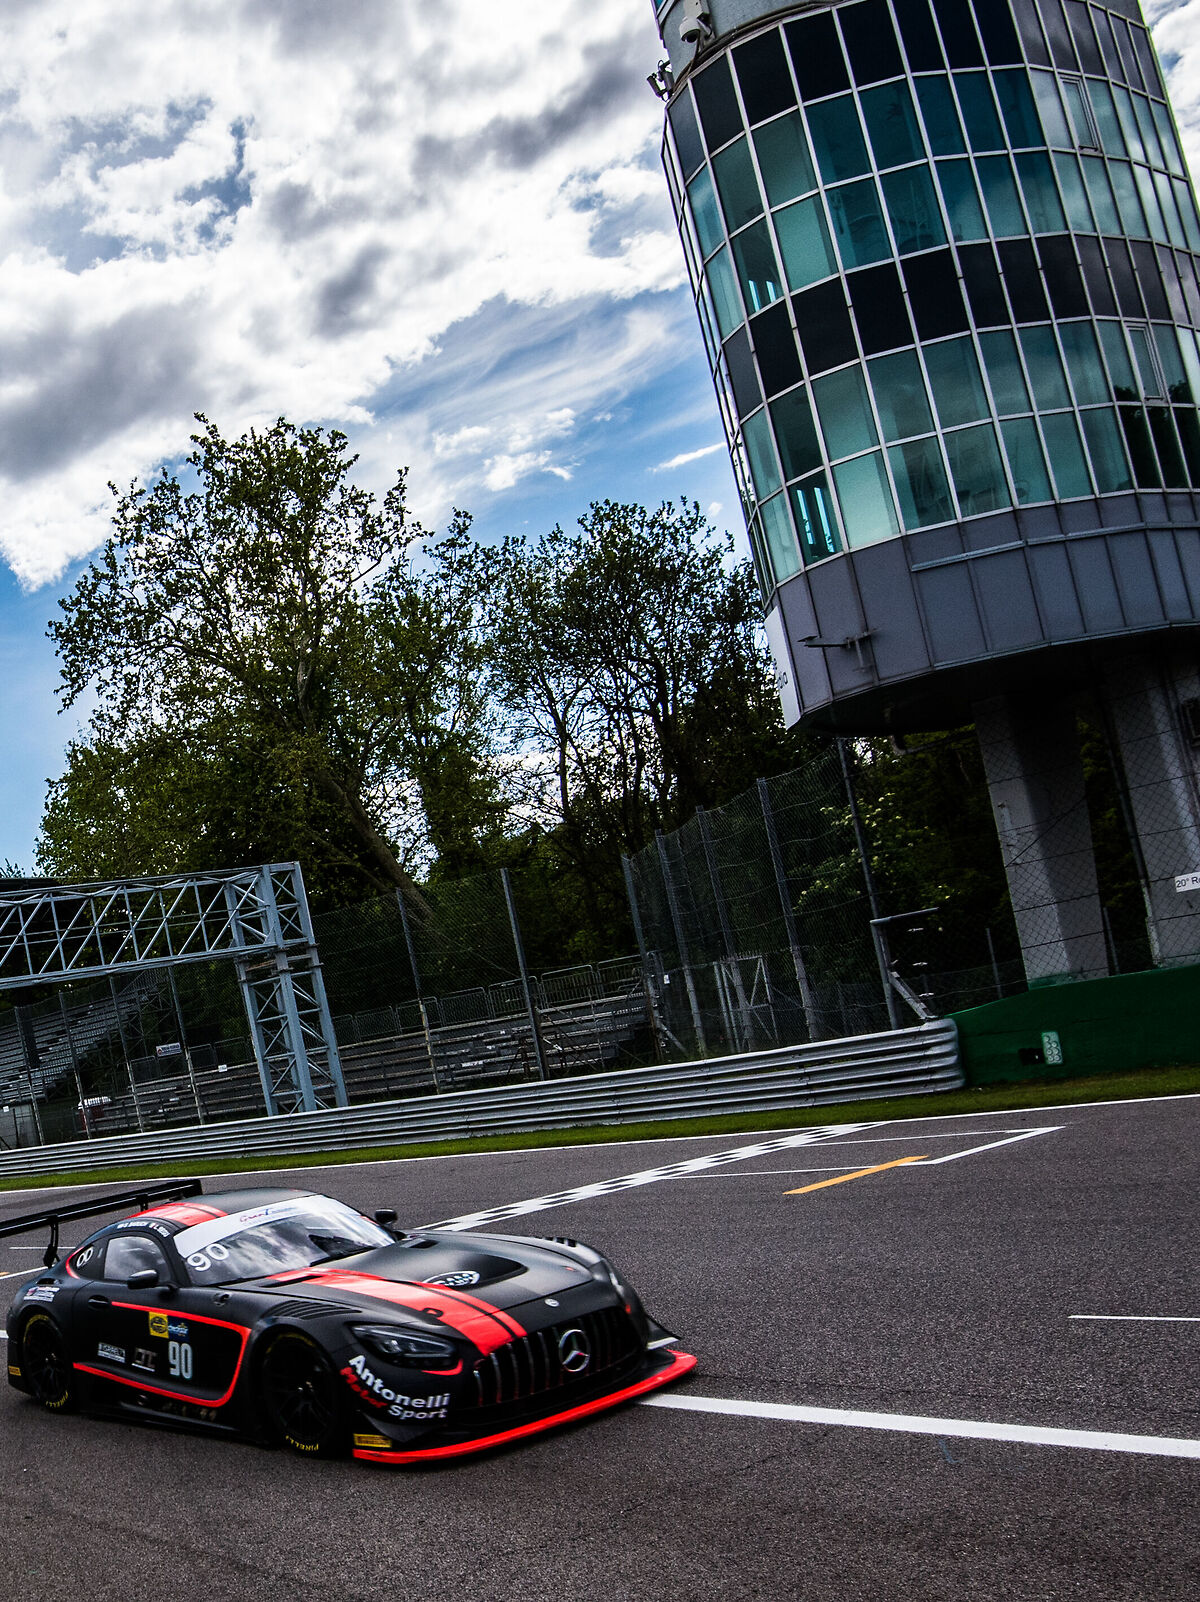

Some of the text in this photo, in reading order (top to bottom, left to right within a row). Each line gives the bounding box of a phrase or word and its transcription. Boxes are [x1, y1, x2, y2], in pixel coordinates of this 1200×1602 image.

[187, 1243, 230, 1272] 90
[168, 1341, 193, 1379] 90
[349, 1355, 451, 1408] Antonelli
[388, 1405, 448, 1420] Sport
